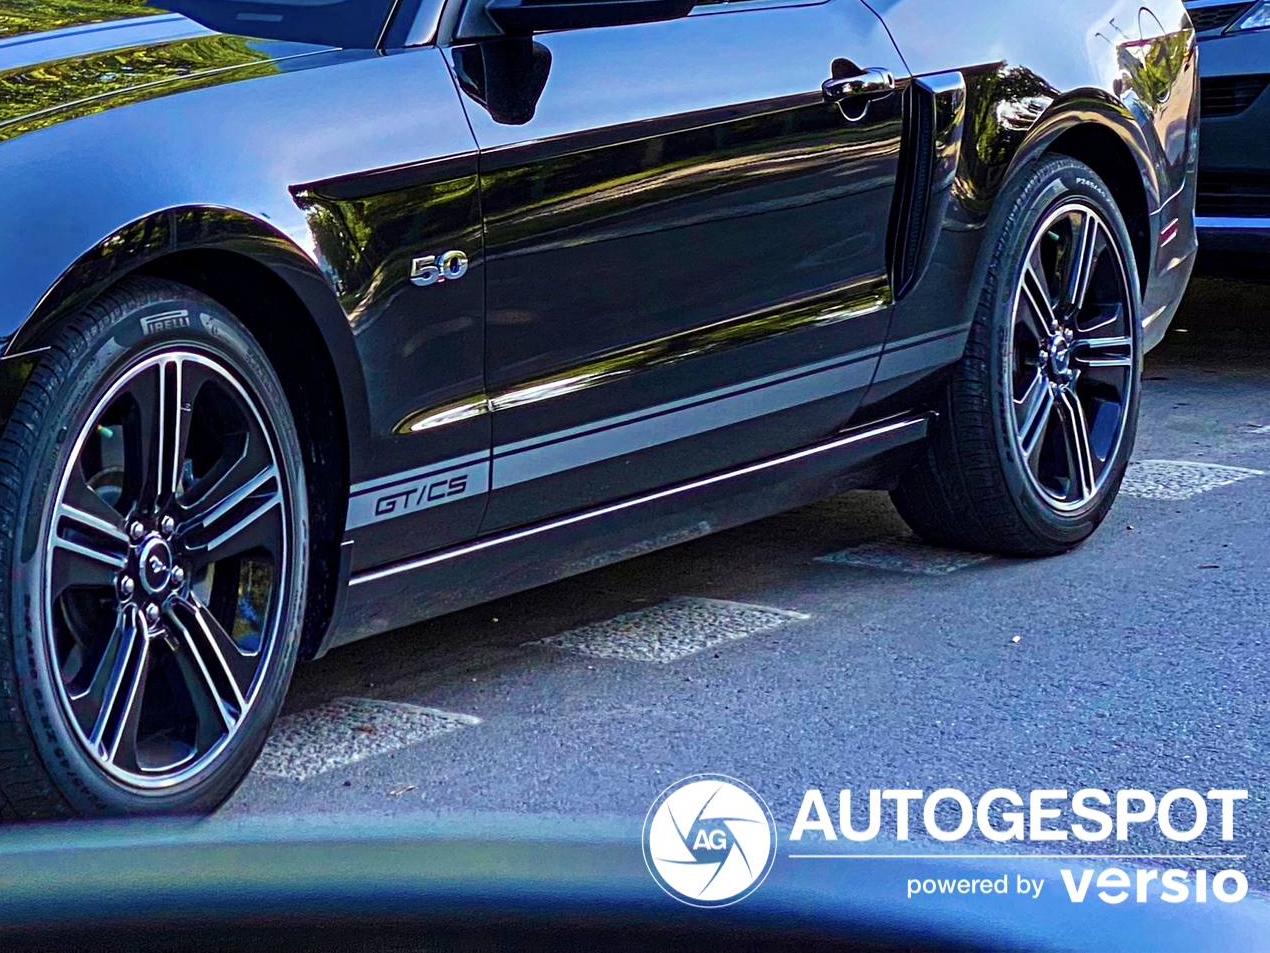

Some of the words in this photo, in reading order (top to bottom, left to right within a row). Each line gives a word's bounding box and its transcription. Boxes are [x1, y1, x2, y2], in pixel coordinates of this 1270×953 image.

[410, 250, 469, 287] 5.0
[139, 309, 191, 337] PIRELLI
[375, 474, 468, 516] GT/CS
